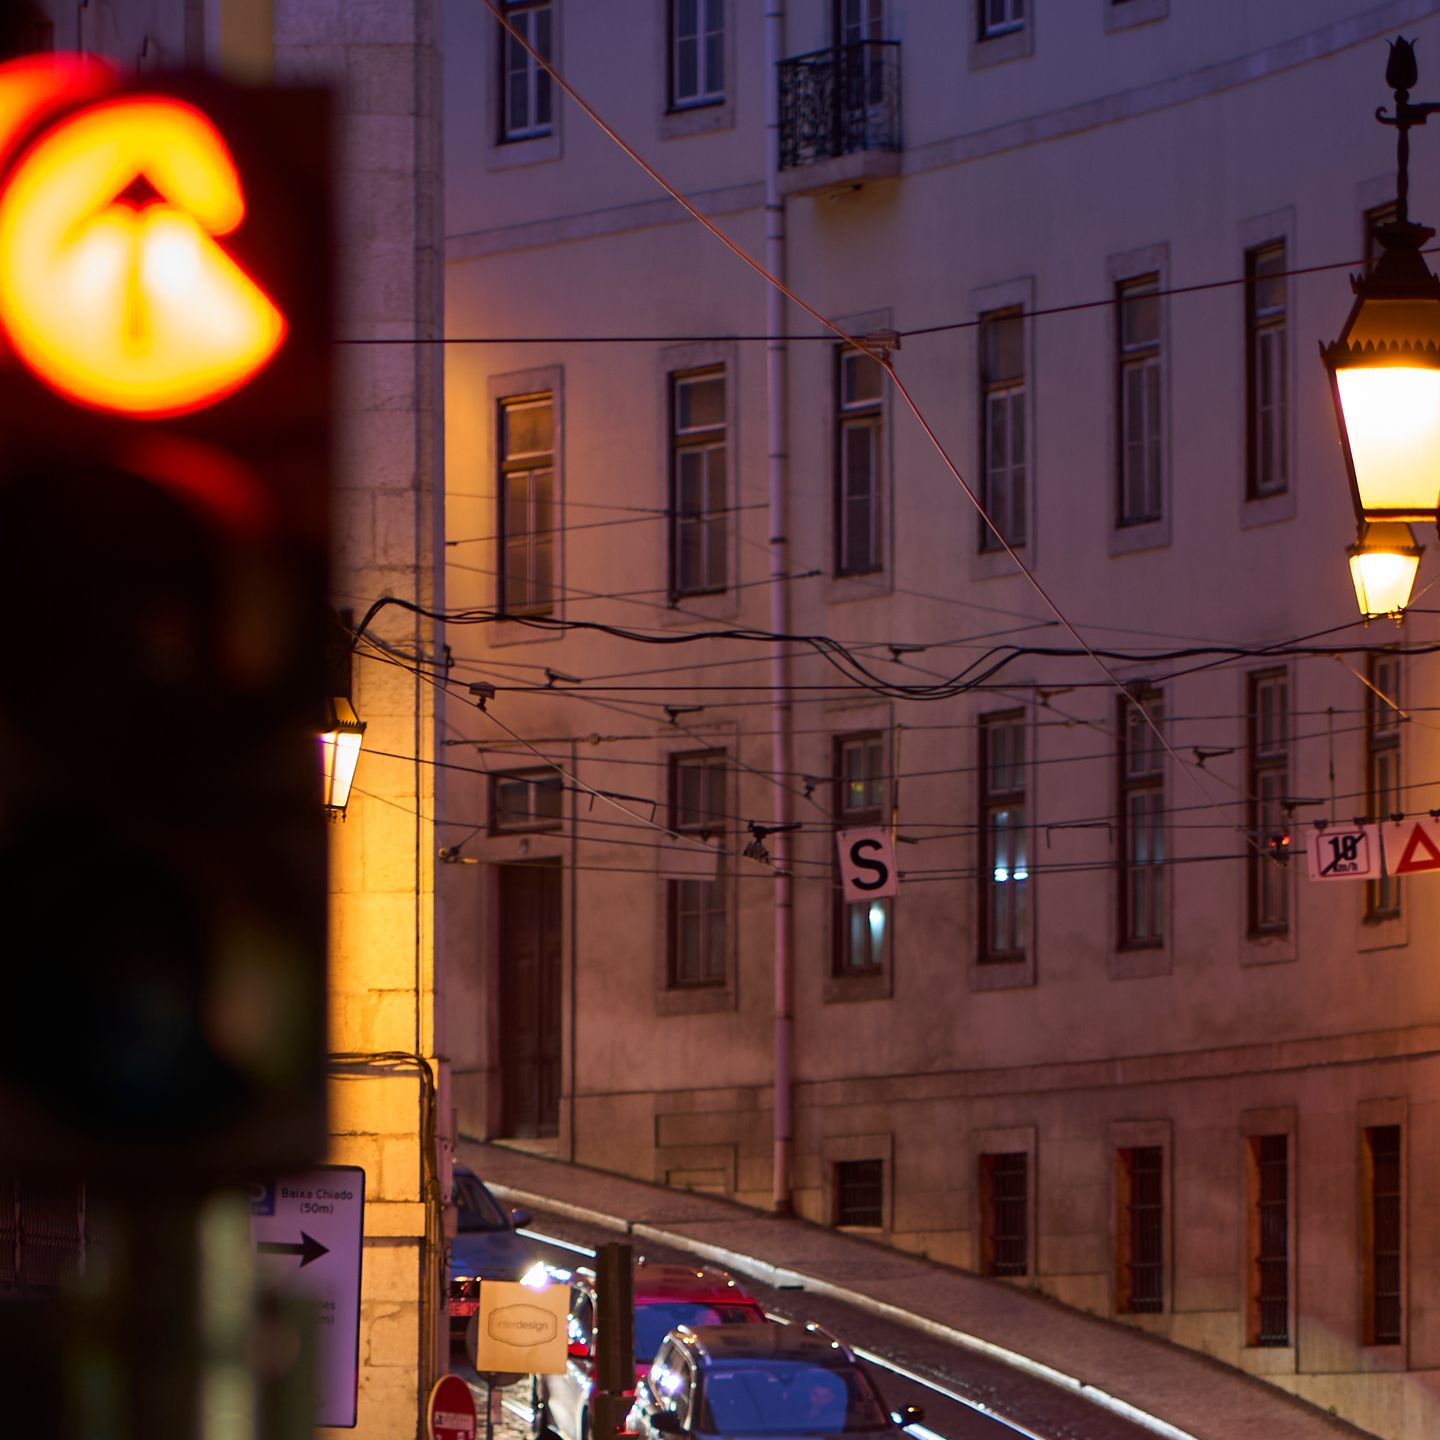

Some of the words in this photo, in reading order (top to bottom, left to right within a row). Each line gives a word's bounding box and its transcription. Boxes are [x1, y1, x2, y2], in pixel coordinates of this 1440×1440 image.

[849, 838, 888, 891] S
[281, 1187, 313, 1199] Baixa
[315, 1188, 353, 1201] Chiado
[299, 1203, 334, 1215] (50m)
